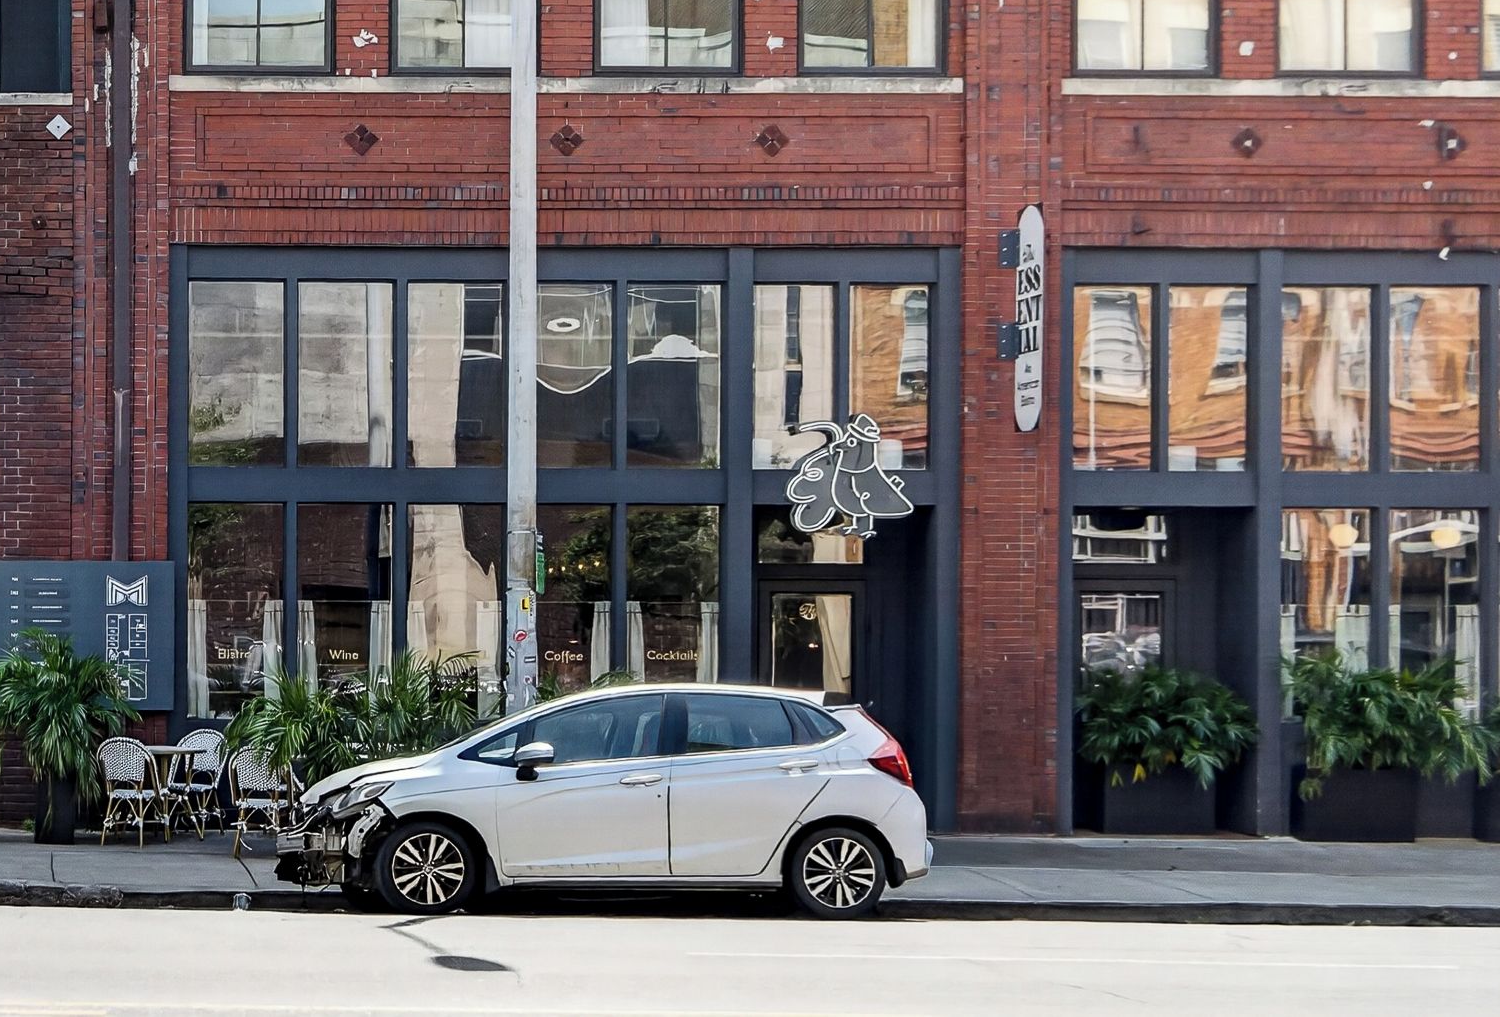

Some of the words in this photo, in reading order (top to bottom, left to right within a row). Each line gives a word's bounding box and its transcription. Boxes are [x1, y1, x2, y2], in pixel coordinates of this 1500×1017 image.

[329, 648, 359, 660] Wine
[544, 650, 584, 664] Coffee
[646, 649, 698, 661] Cocktails
